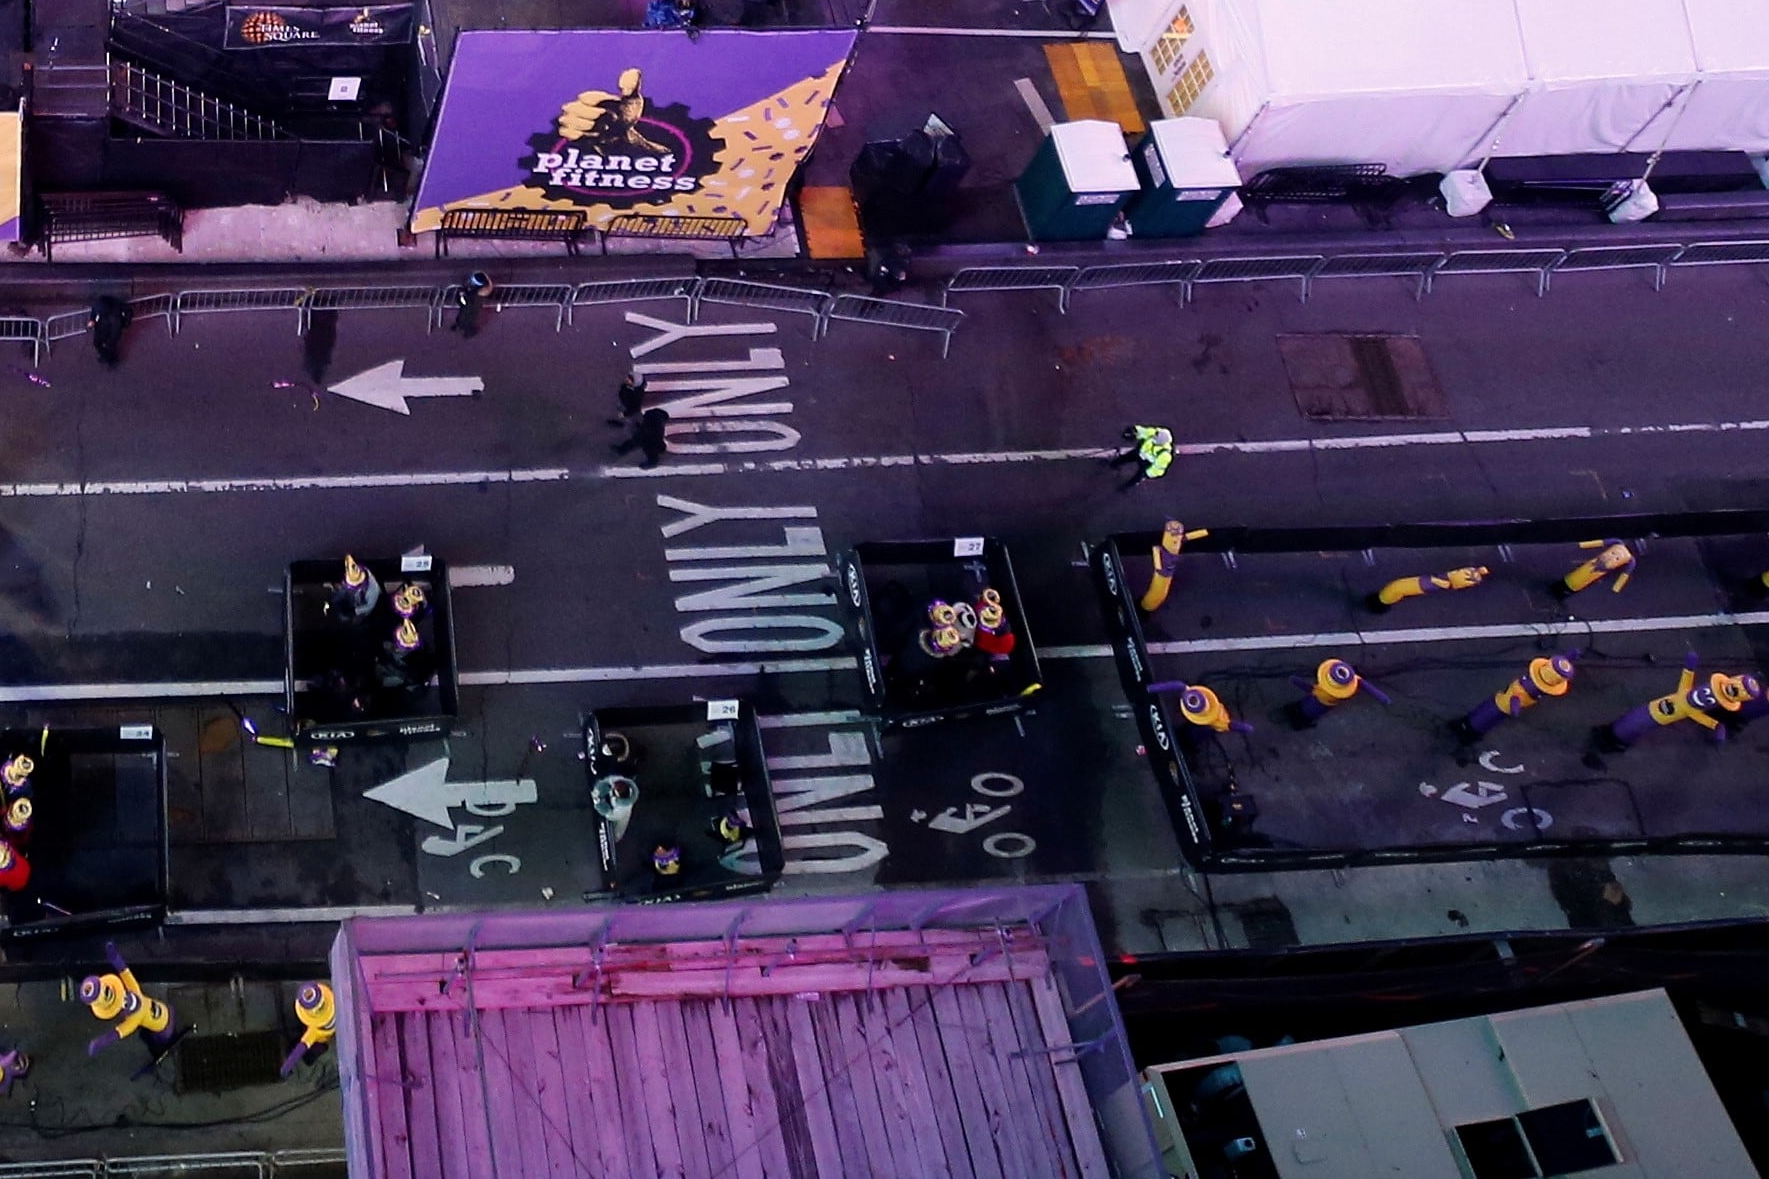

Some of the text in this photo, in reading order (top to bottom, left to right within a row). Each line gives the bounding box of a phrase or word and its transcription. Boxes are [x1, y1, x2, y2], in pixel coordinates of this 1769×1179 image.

[260, 23, 300, 32] TIMES
[266, 31, 320, 41] SQUARE
[533, 148, 676, 173] planet
[549, 168, 696, 191] fitness
[625, 312, 802, 454] ONLY
[657, 495, 845, 654] ONLY
[849, 567, 860, 603] KIA
[1105, 556, 1117, 592] KIA
[722, 706, 736, 714] 26
[1152, 709, 1168, 747] KIA
